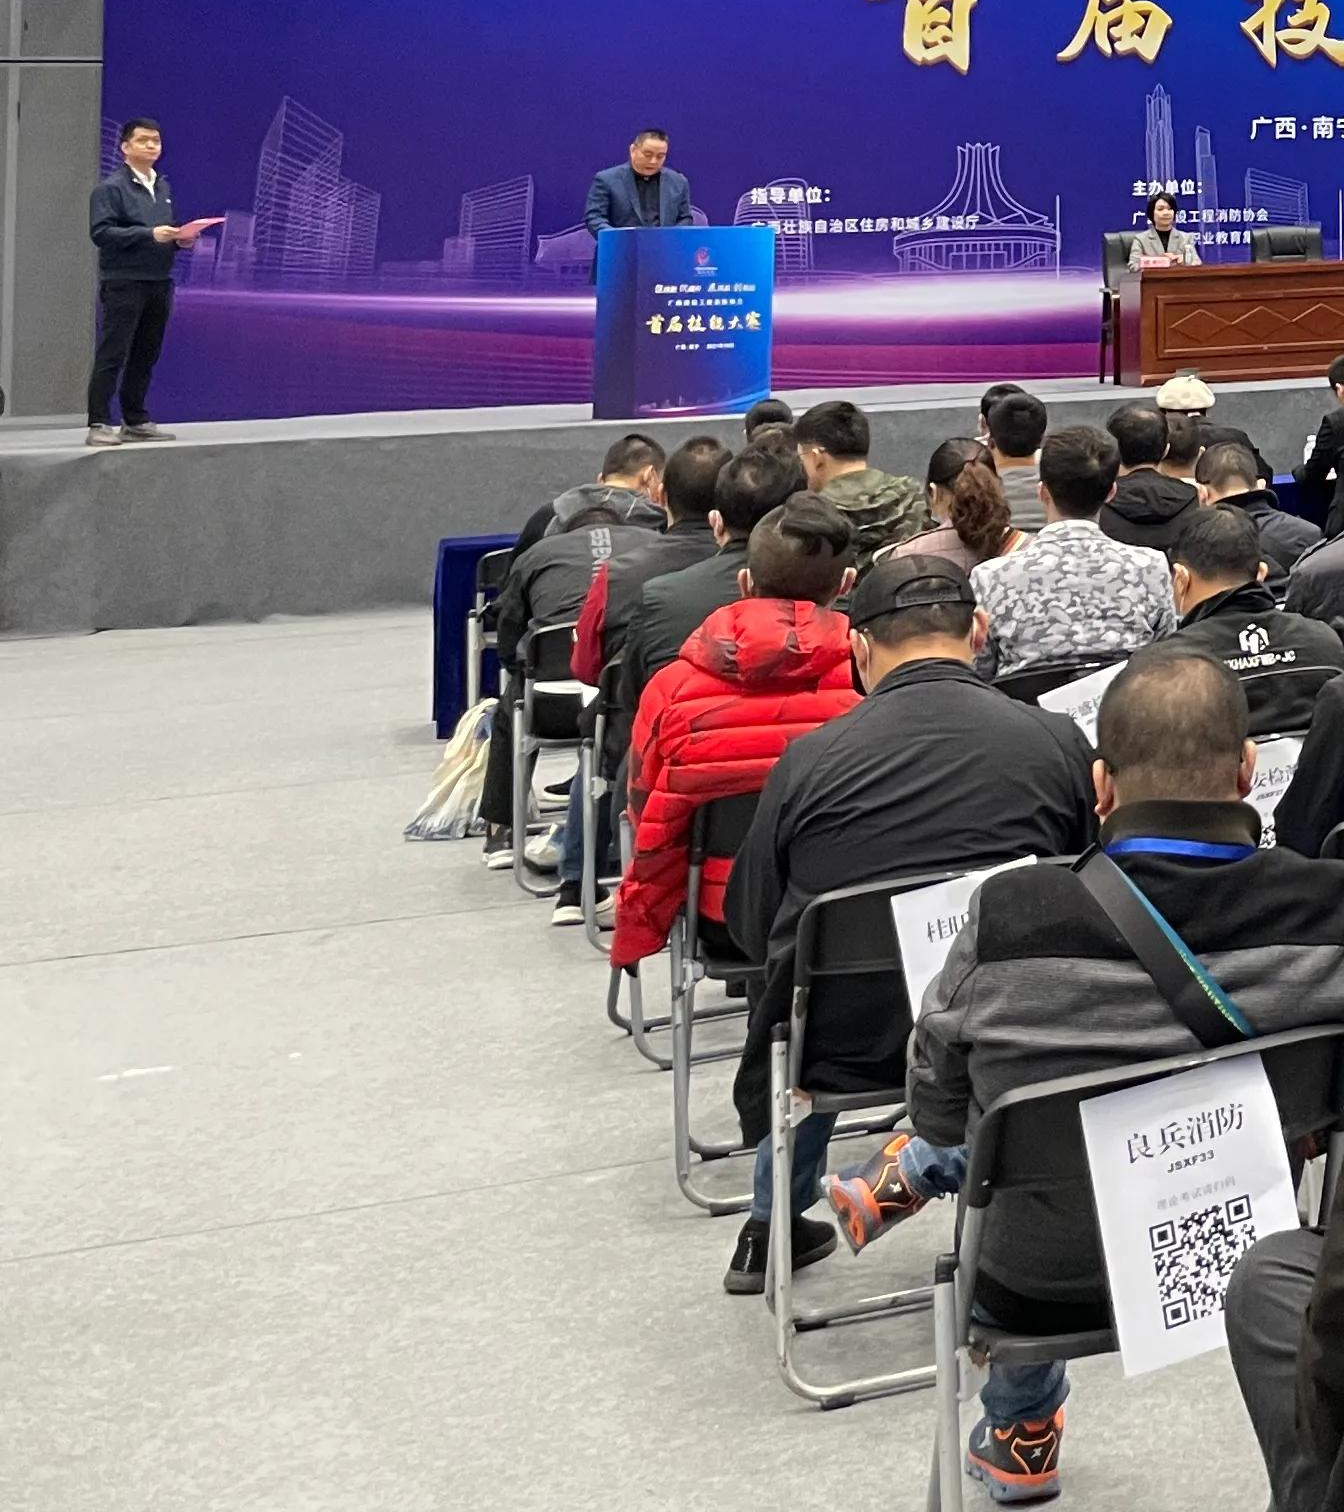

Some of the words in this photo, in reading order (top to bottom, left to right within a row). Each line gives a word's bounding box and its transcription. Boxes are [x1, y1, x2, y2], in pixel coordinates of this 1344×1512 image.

[1126, 1103, 1244, 1164] 良兵消防
[1167, 1149, 1215, 1173] JSXF33
